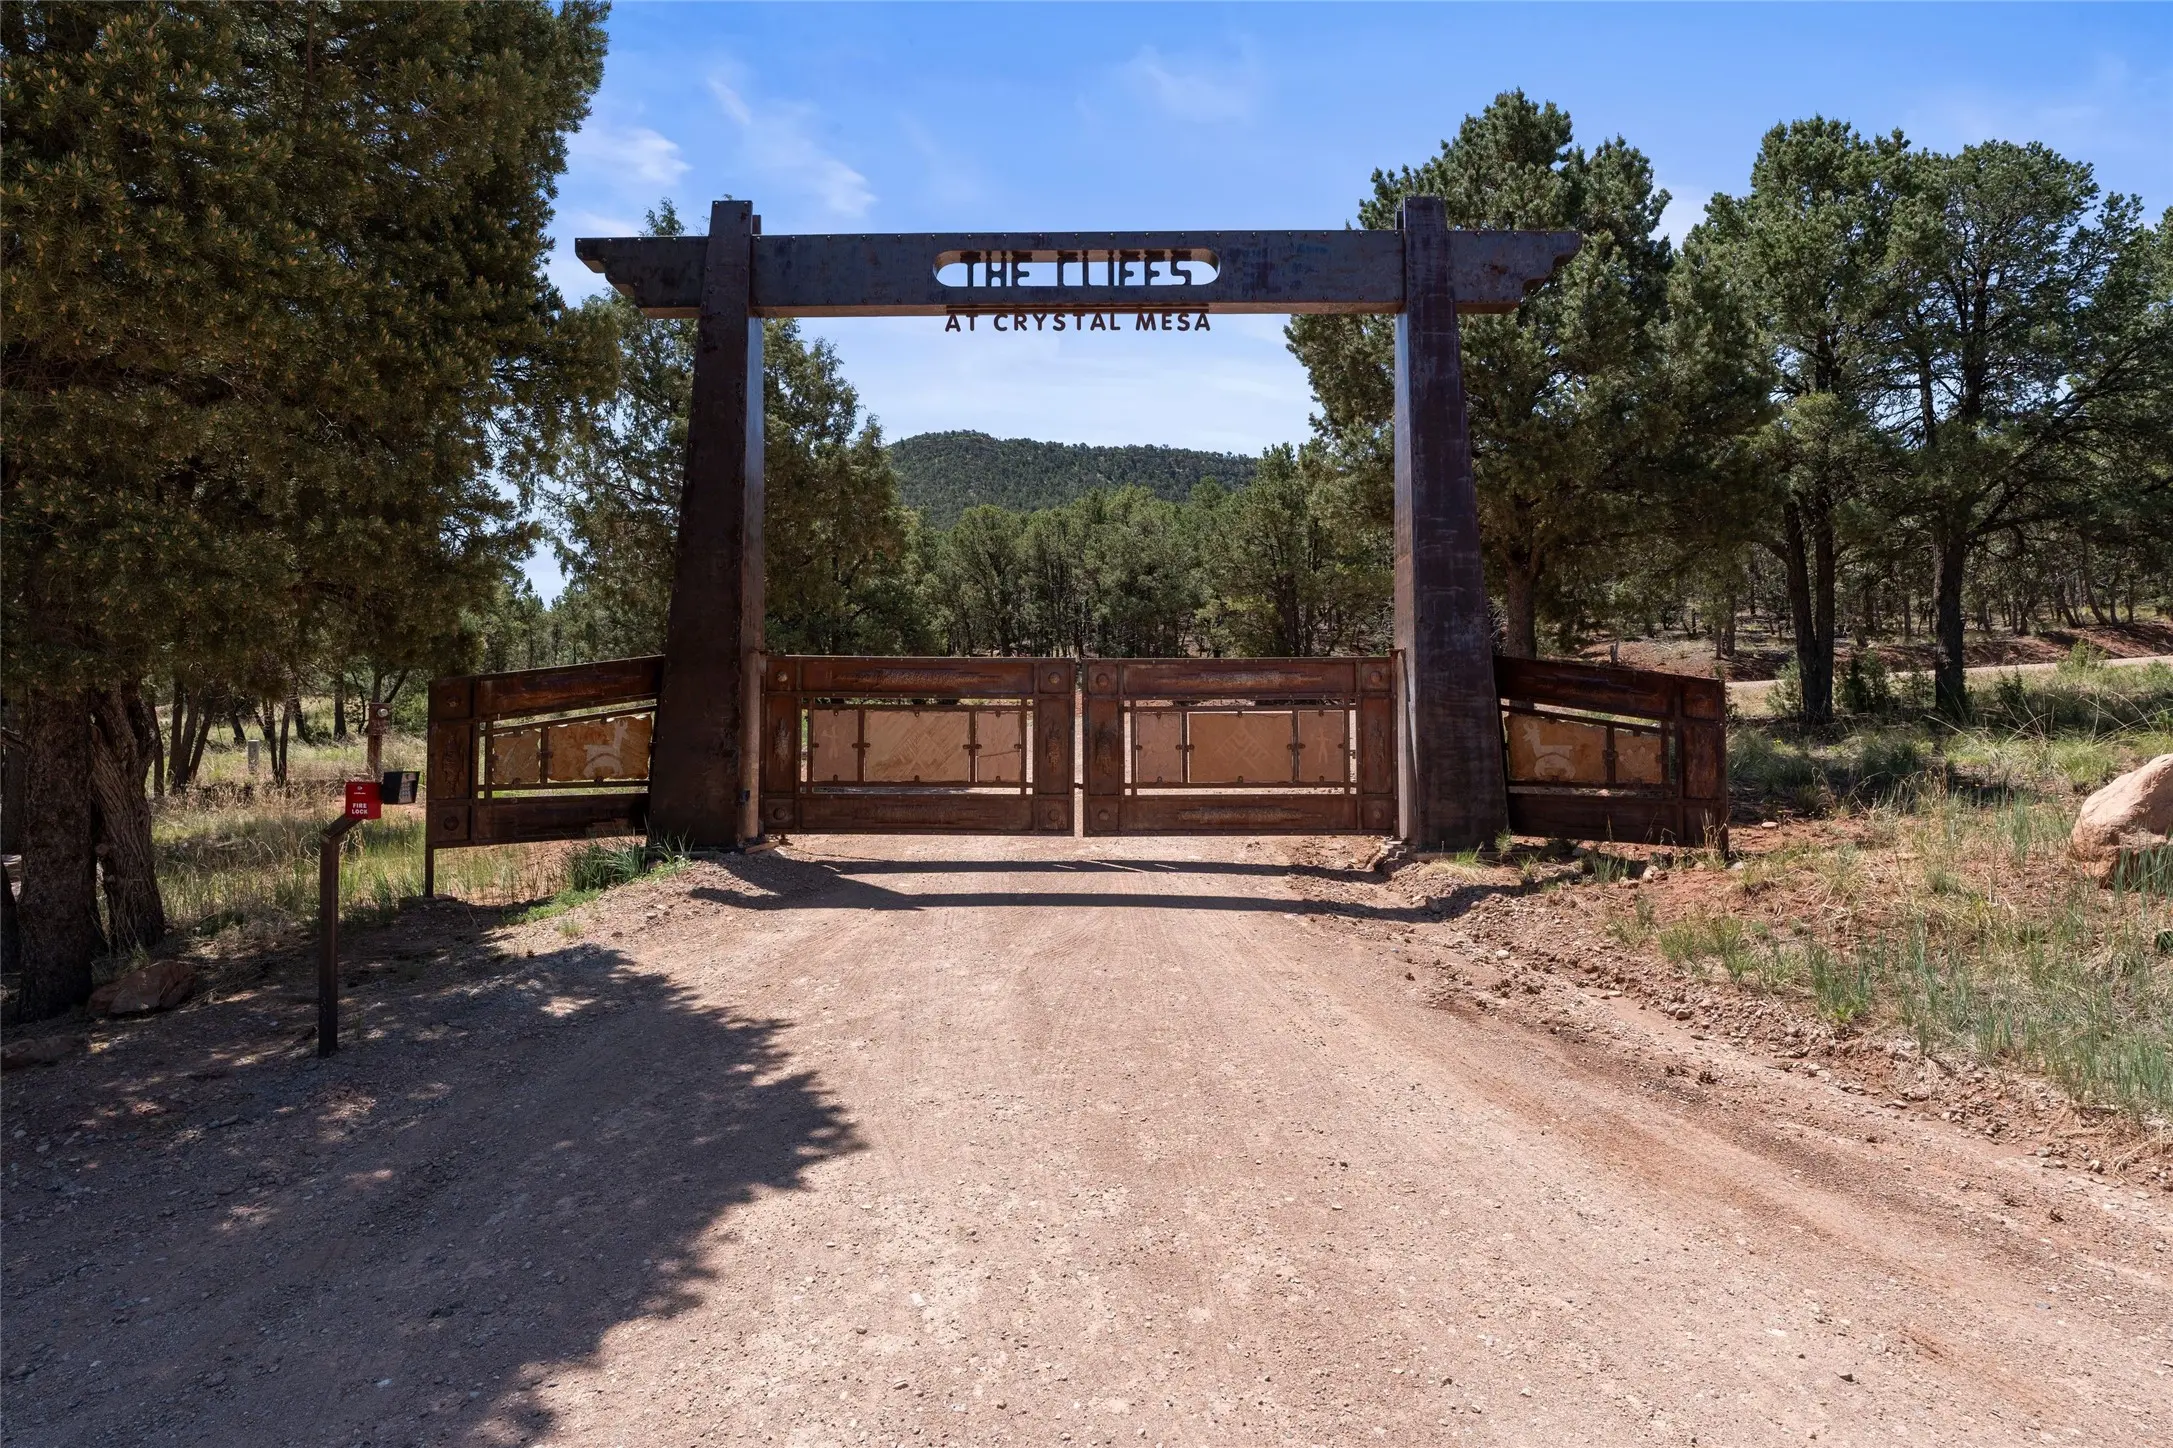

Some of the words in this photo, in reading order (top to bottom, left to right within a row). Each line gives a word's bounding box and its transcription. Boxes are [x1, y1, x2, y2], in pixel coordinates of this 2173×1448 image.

[960, 250, 1032, 287] THE
[945, 313, 978, 332] AT
[993, 313, 1121, 331] CRYSTAL
[1136, 313, 1211, 331] MESA
